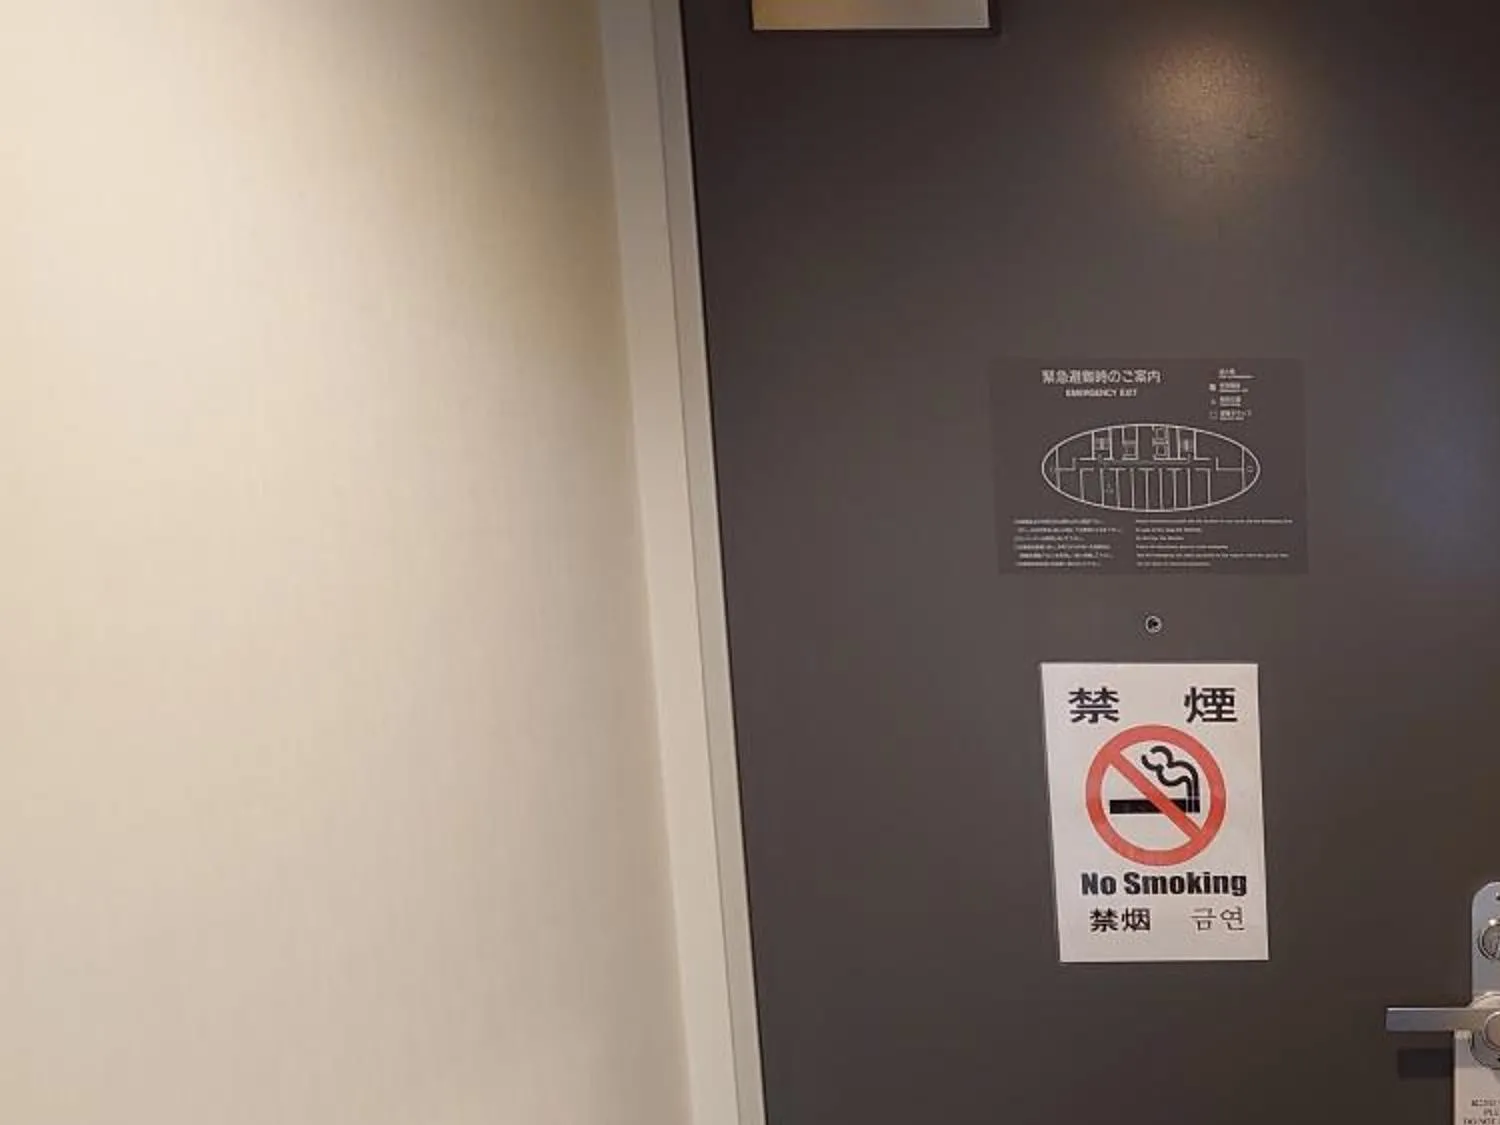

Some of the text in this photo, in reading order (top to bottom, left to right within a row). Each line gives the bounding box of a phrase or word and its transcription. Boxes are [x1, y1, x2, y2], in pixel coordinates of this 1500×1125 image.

[1041, 369, 1161, 384] 緊急避難時のご案内
[1081, 871, 1247, 897] No Smoking
[1089, 907, 1151, 932] 禁烟
[1191, 906, 1245, 931] 금연
